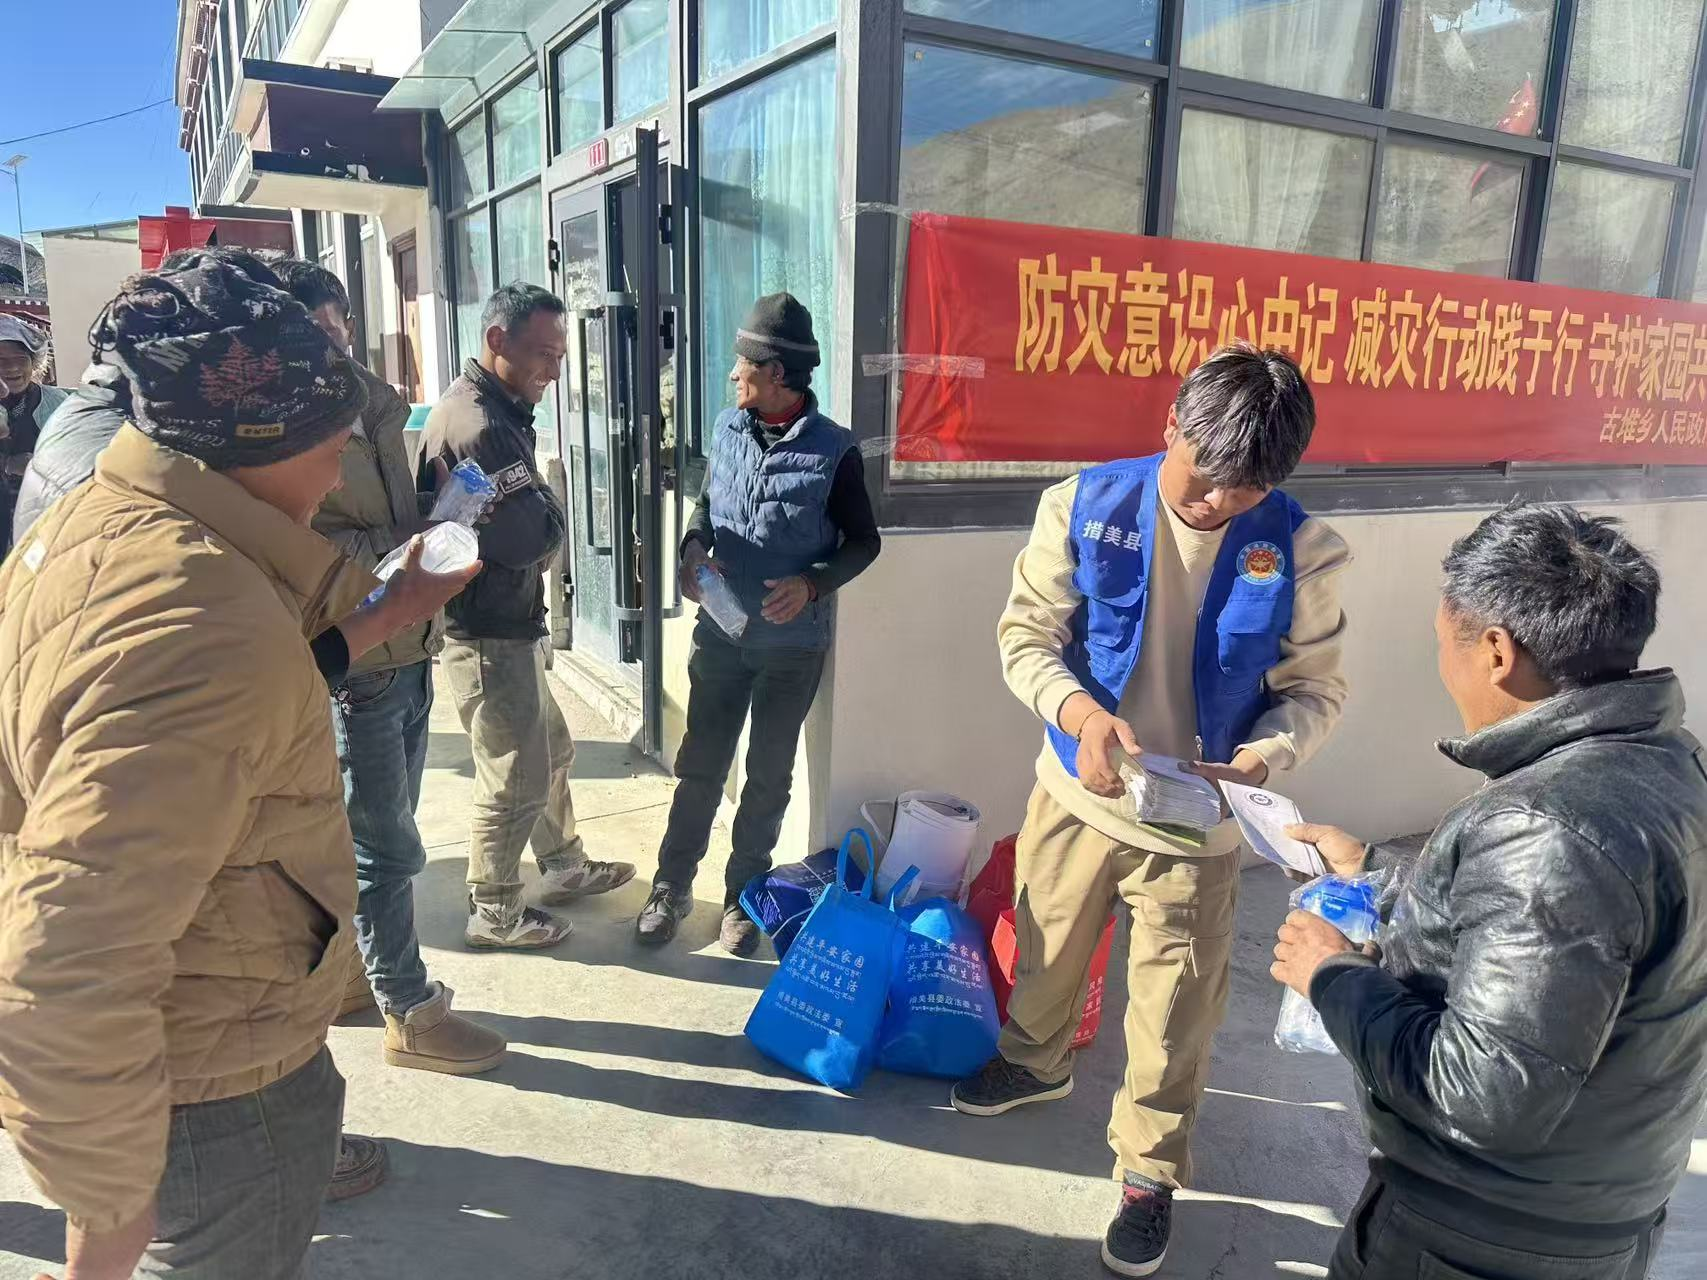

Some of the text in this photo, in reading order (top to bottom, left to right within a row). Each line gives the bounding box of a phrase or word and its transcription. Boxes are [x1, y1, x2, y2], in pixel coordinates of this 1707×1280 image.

[1015, 253, 1338, 384] 防灾意识心中记
[1344, 287, 1585, 397] 减灾行动践于行
[1599, 406, 1707, 446] 古堆乡人民政
[1082, 519, 1143, 552] 措美县
[800, 931, 864, 968] 共建平安家园
[907, 942, 979, 961] 共建平安家园
[789, 953, 858, 992] 共享美好生活
[907, 960, 981, 982] 共享美好生活
